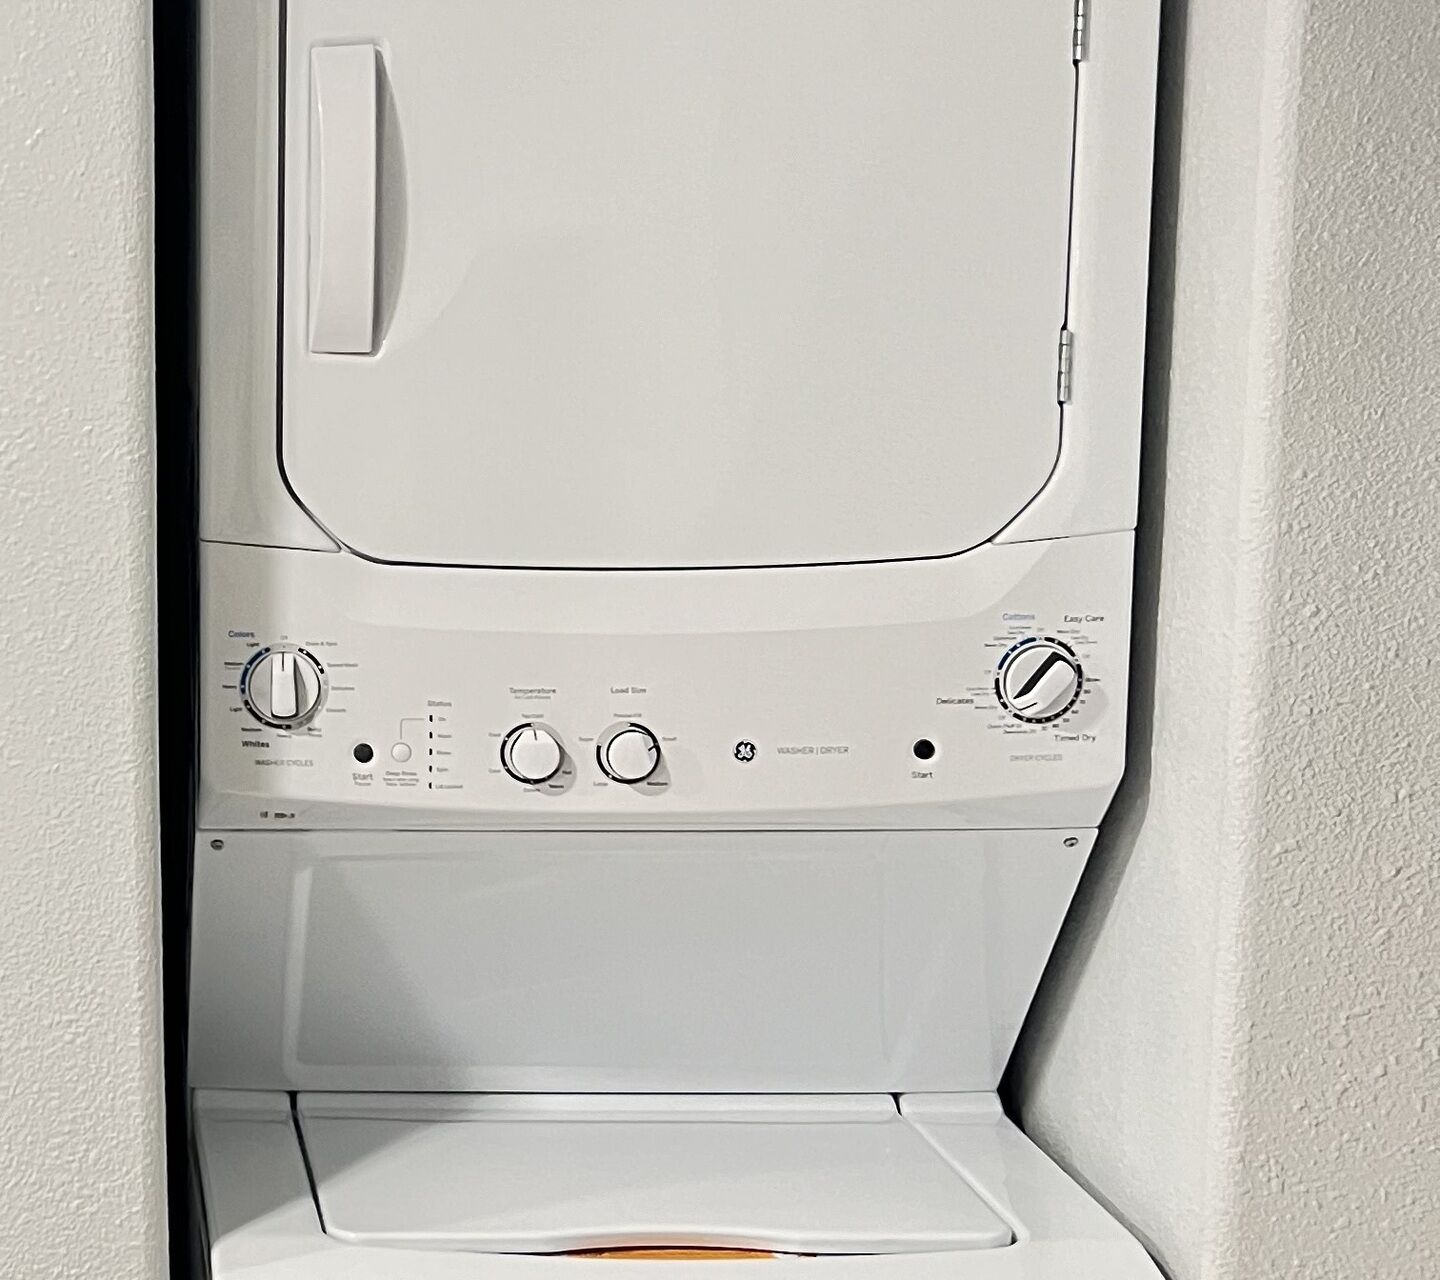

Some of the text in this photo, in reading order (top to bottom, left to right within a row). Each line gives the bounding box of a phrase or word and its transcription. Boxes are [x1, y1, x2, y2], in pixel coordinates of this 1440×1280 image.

[1064, 614, 1104, 623] Easy Care
[1082, 733, 1097, 743] Dry
[911, 771, 933, 779] Start
